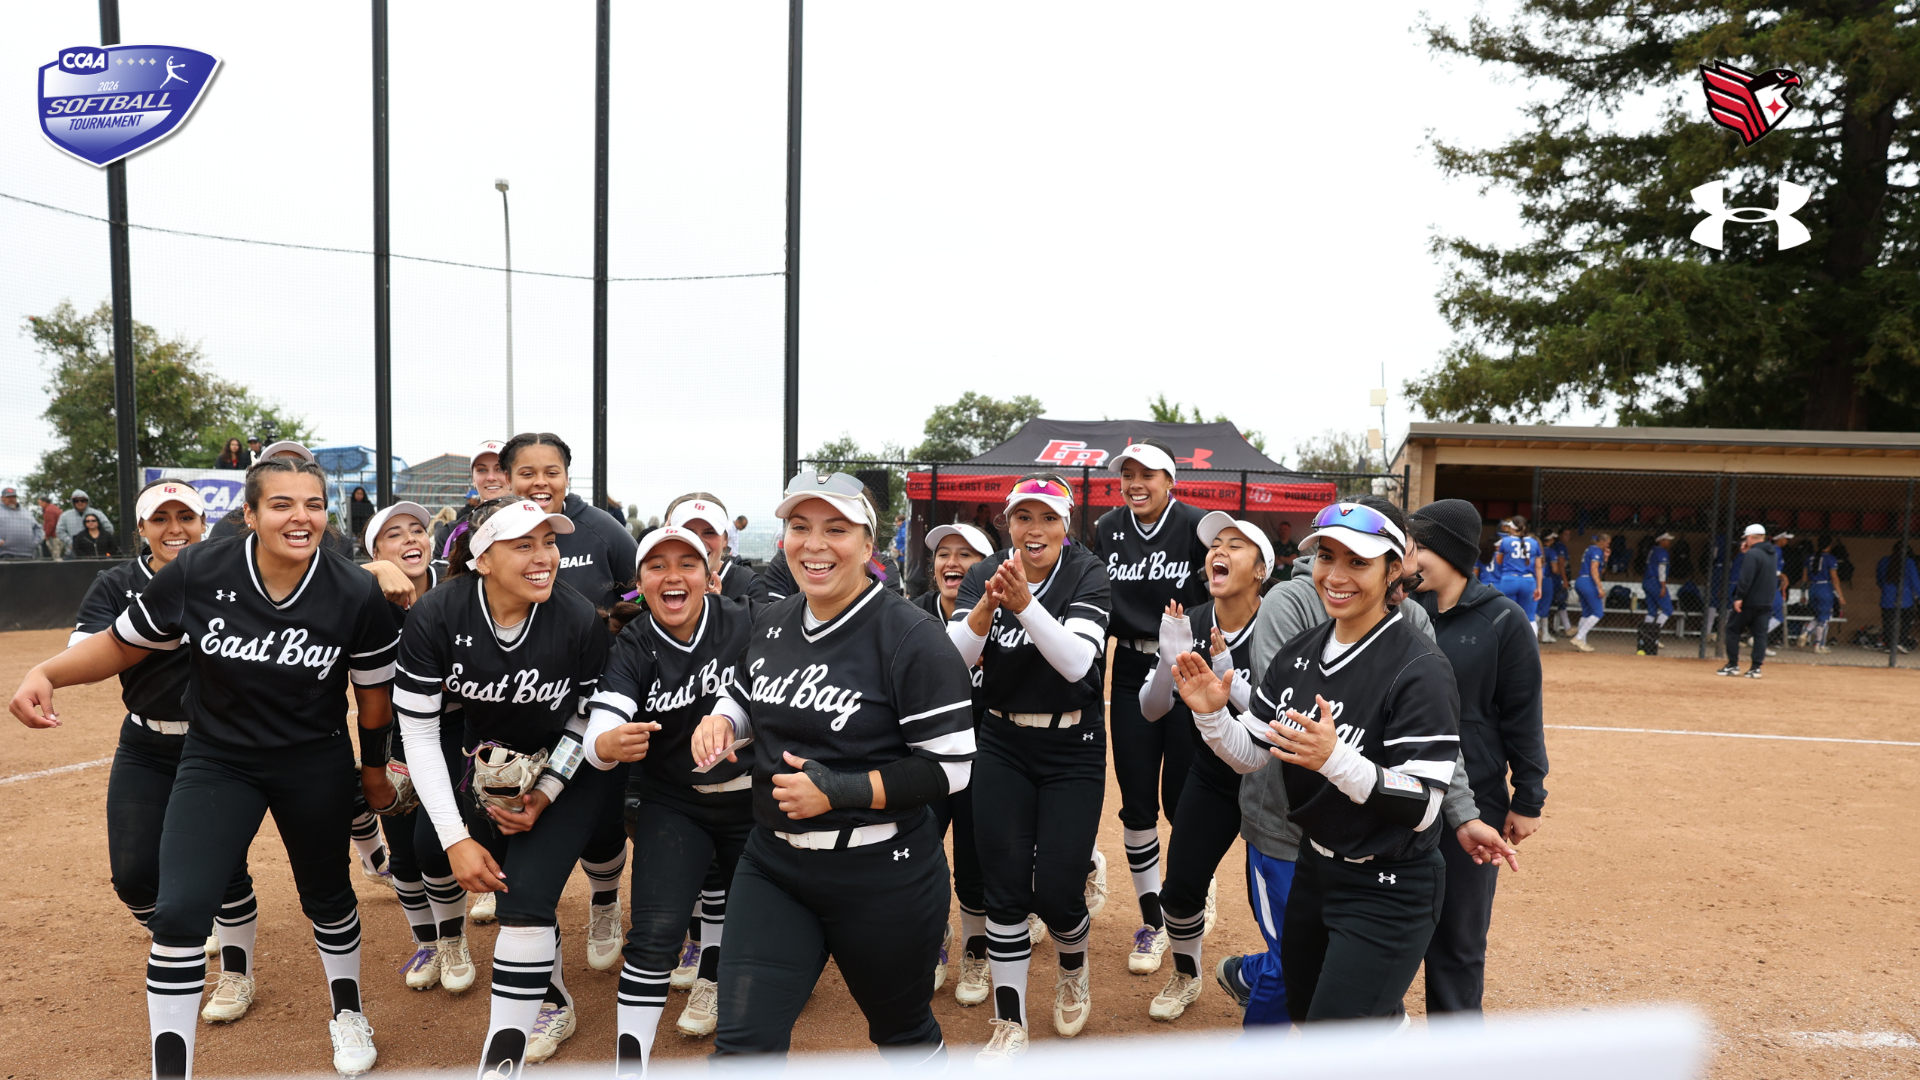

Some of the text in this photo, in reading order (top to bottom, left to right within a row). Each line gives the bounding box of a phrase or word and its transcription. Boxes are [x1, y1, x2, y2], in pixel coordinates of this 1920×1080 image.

[194, 485, 246, 511] CAA
[908, 482, 925, 491] CAL
[959, 482, 982, 491] EAST
[984, 483, 1001, 491] BAY
[1192, 489, 1216, 498] EAST
[1219, 489, 1237, 498] BAY
[1284, 491, 1333, 501] PIONEERS
[559, 554, 594, 569] BALL
[1106, 550, 1191, 589] East Bay
[200, 617, 342, 680] East Bay
[445, 662, 571, 711] East Bay
[645, 658, 735, 713] East Ba
[789, 663, 863, 732] Bay
